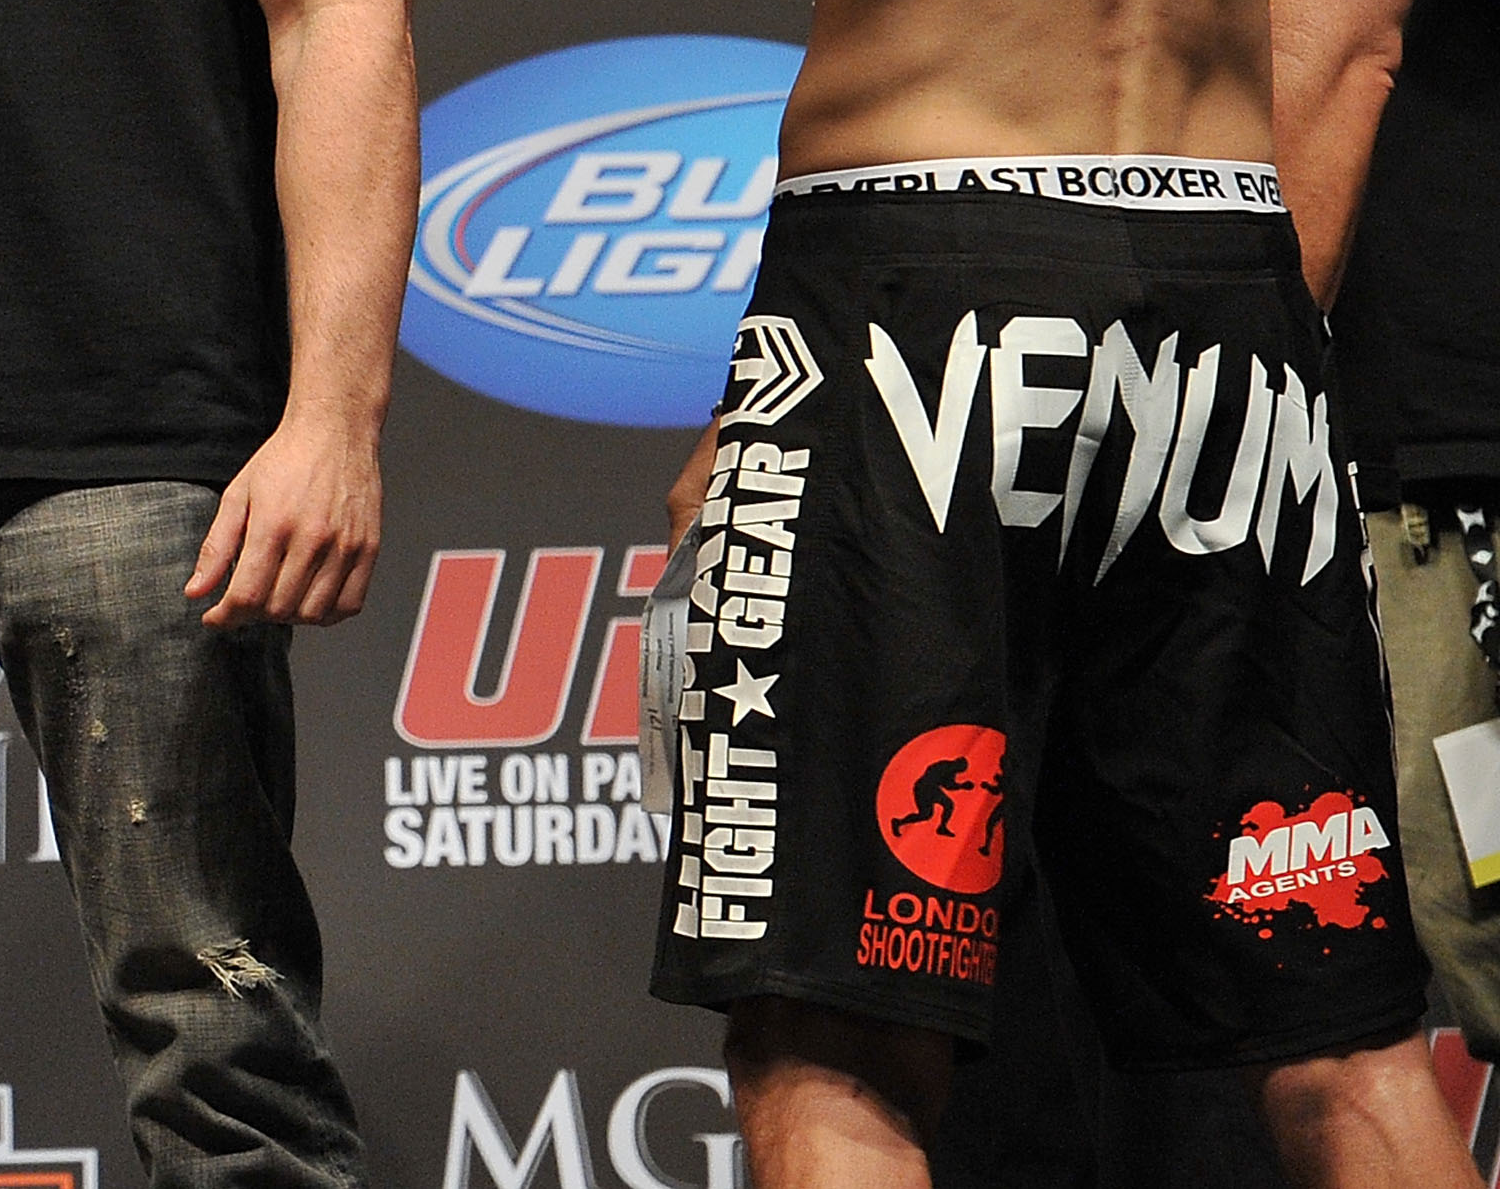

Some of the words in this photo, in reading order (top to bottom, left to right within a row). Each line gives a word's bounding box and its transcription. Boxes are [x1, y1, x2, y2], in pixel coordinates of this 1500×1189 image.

[544, 151, 779, 224] BU
[465, 206, 764, 296] LIG
[864, 310, 1340, 587] VENUM
[718, 442, 810, 648] GEAR
[385, 754, 488, 806] LIVE
[500, 753, 569, 804] ON
[701, 733, 777, 939] FIGHT
[1227, 806, 1391, 885] MMA
[864, 888, 997, 938] LONDO
[1227, 861, 1357, 904] AGENTS
[443, 1066, 745, 1189] MG
